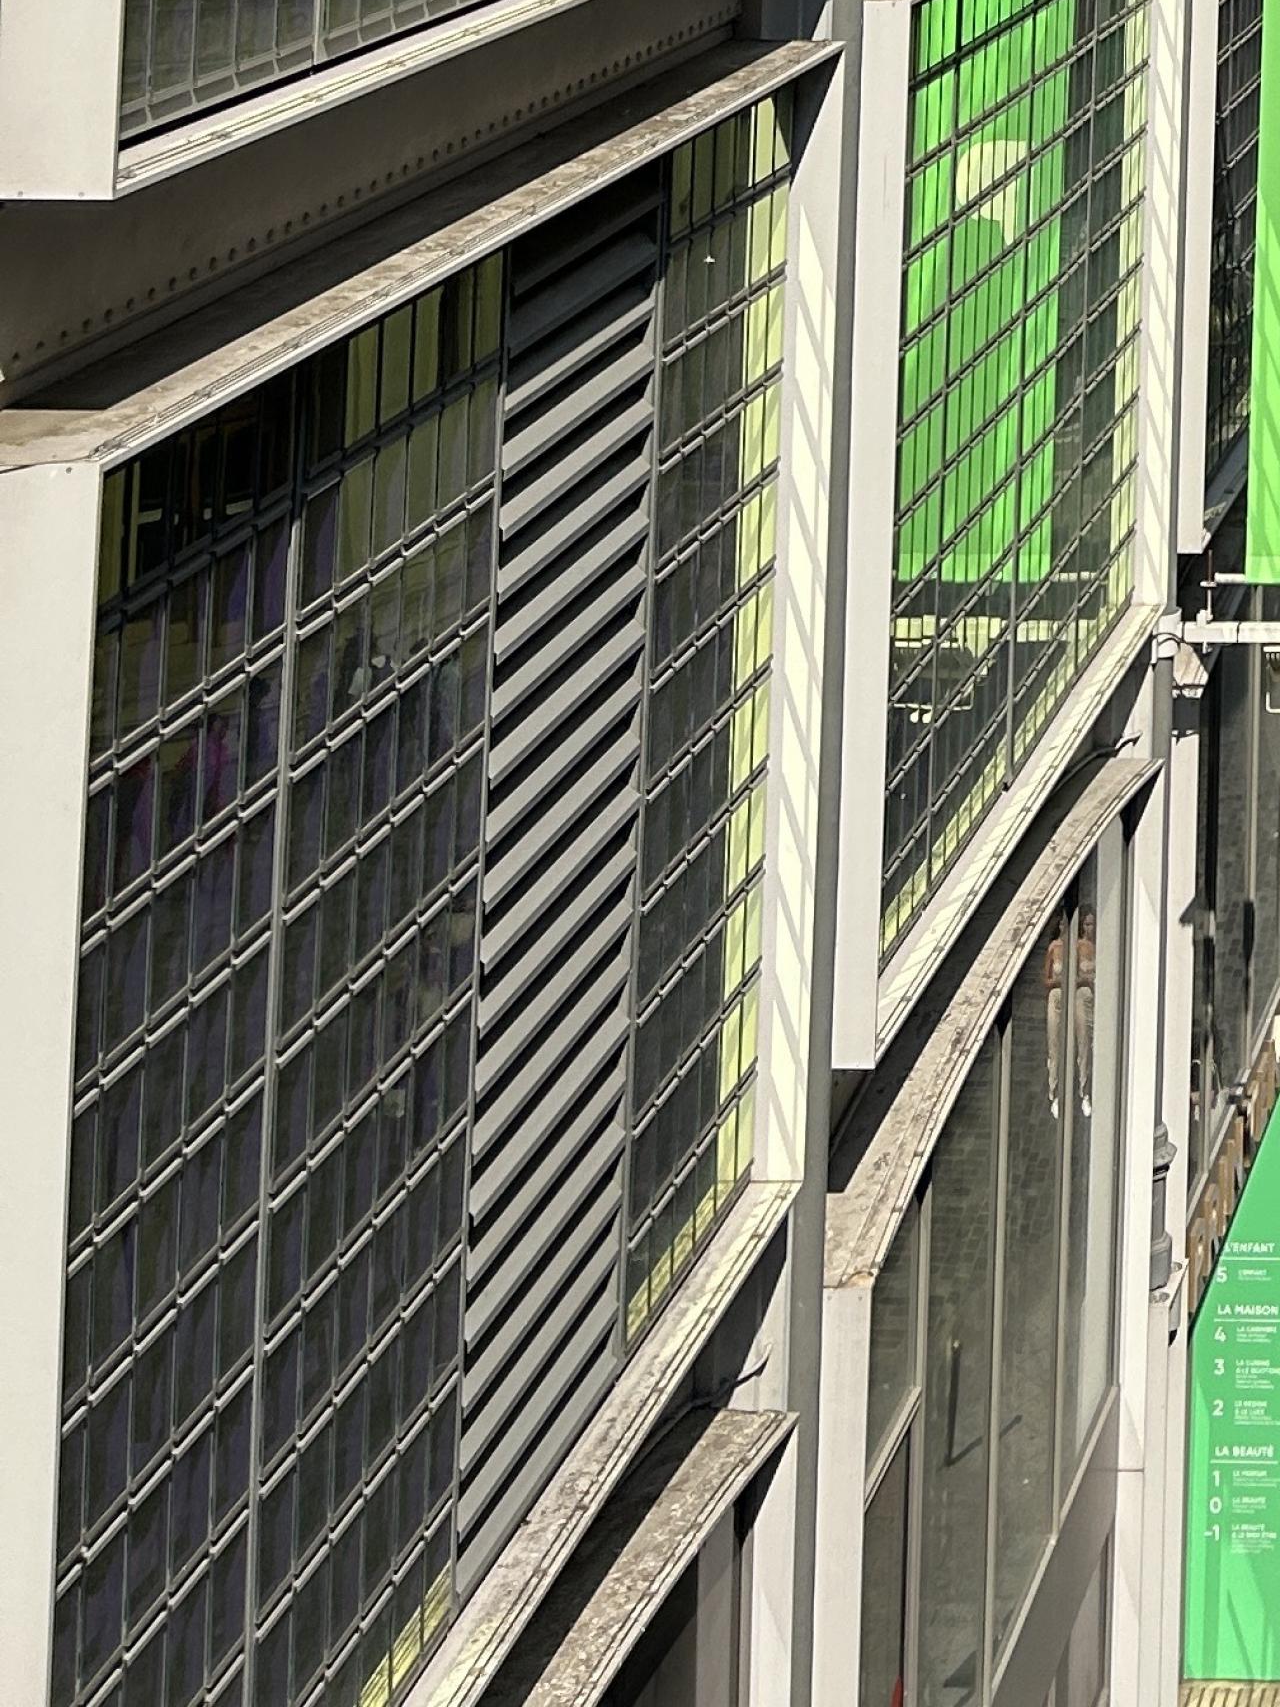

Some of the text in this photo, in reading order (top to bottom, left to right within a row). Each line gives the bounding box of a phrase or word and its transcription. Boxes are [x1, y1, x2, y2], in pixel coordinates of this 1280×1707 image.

[1226, 1242, 1275, 1253] L'ENFANT
[1216, 1267, 1228, 1283] 5
[1217, 1305, 1280, 1316] LA MAISON
[1214, 1326, 1227, 1342] 4
[1214, 1358, 1225, 1375] 3
[1212, 1399, 1224, 1417] 2
[1215, 1444, 1274, 1458] LA BEAUTÉ
[1211, 1469, 1221, 1487] 1
[1209, 1496, 1222, 1515] 0
[1204, 1524, 1220, 1542] -1
